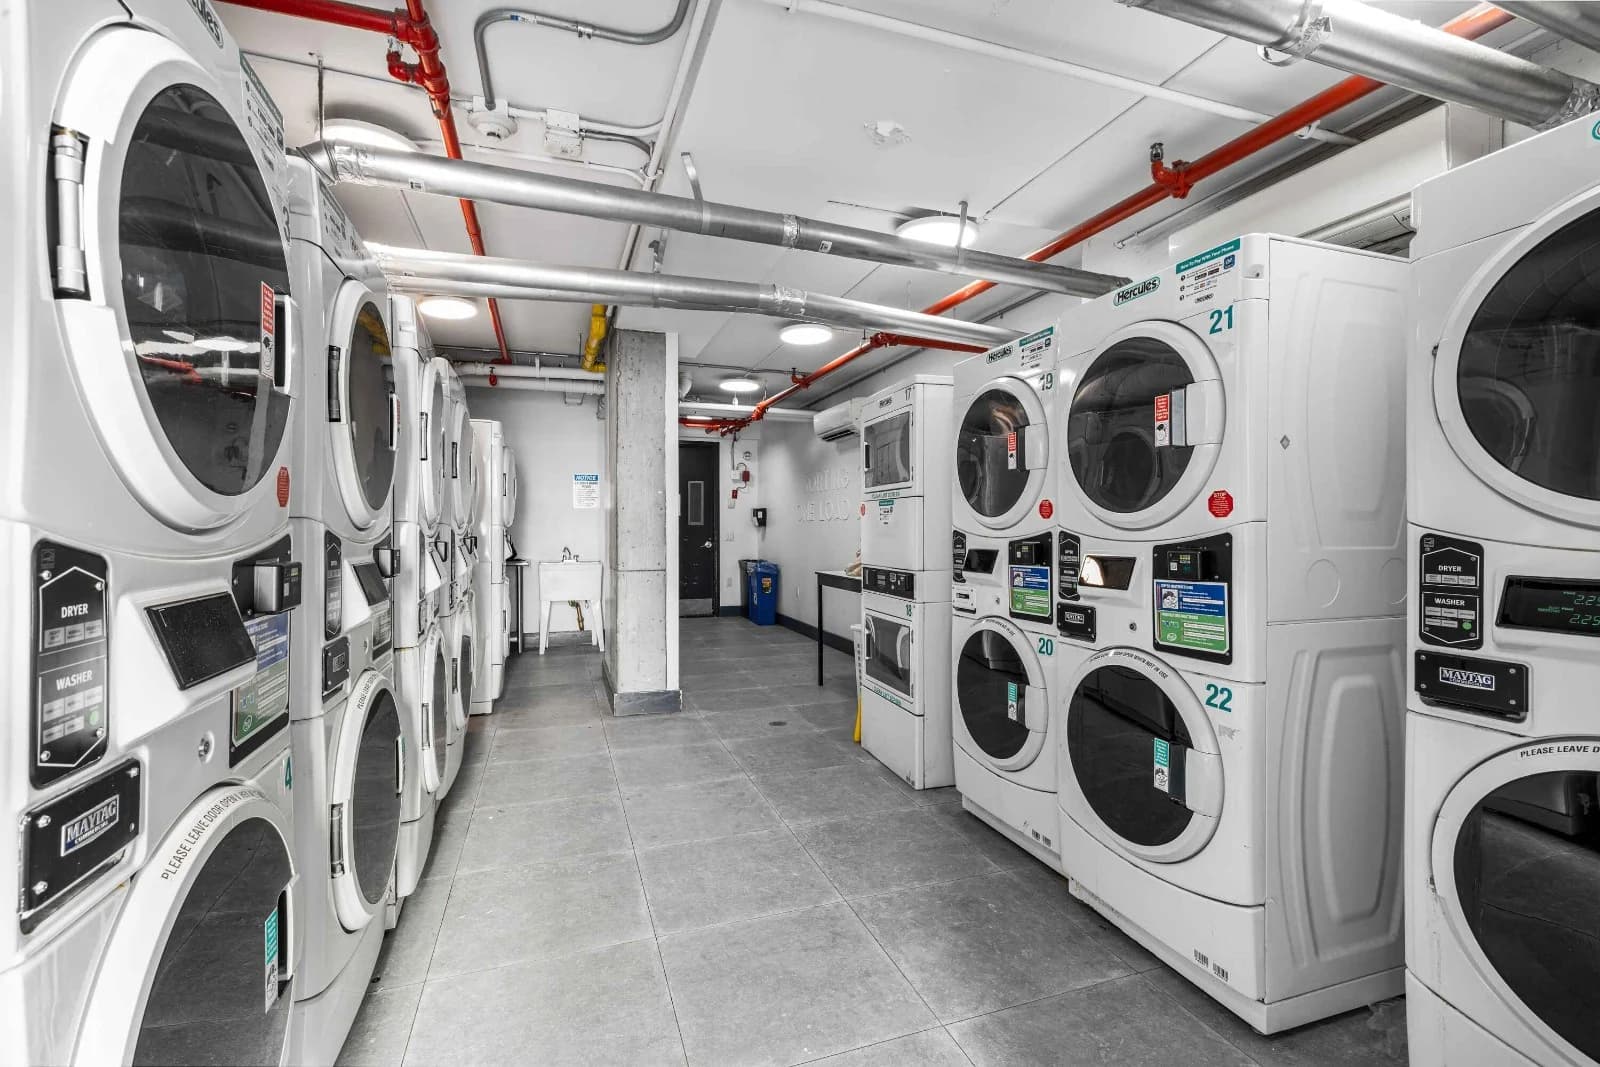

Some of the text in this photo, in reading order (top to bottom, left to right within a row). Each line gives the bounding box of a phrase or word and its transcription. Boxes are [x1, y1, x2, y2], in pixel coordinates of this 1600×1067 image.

[283, 206, 290, 242] 3
[1116, 279, 1158, 303] Hercules
[1209, 305, 1233, 334] 21
[1040, 373, 1053, 391] 19
[1438, 564, 1462, 572] DRYER
[61, 603, 88, 618] DRYER
[905, 604, 912, 617] 18
[1434, 597, 1465, 606] WASHER
[1039, 638, 1053, 655] 20
[56, 669, 93, 691] WASHER
[1442, 669, 1492, 685] MAYTAG
[1205, 683, 1232, 712] 22
[1520, 746, 1555, 758] PLEASE
[1557, 745, 1590, 753] LEAVE
[285, 756, 292, 790] 4
[66, 800, 117, 843] MAYTAG
[161, 842, 192, 880] PLEASE
[184, 819, 209, 845] LEAVE
[203, 804, 225, 823] DOOR
